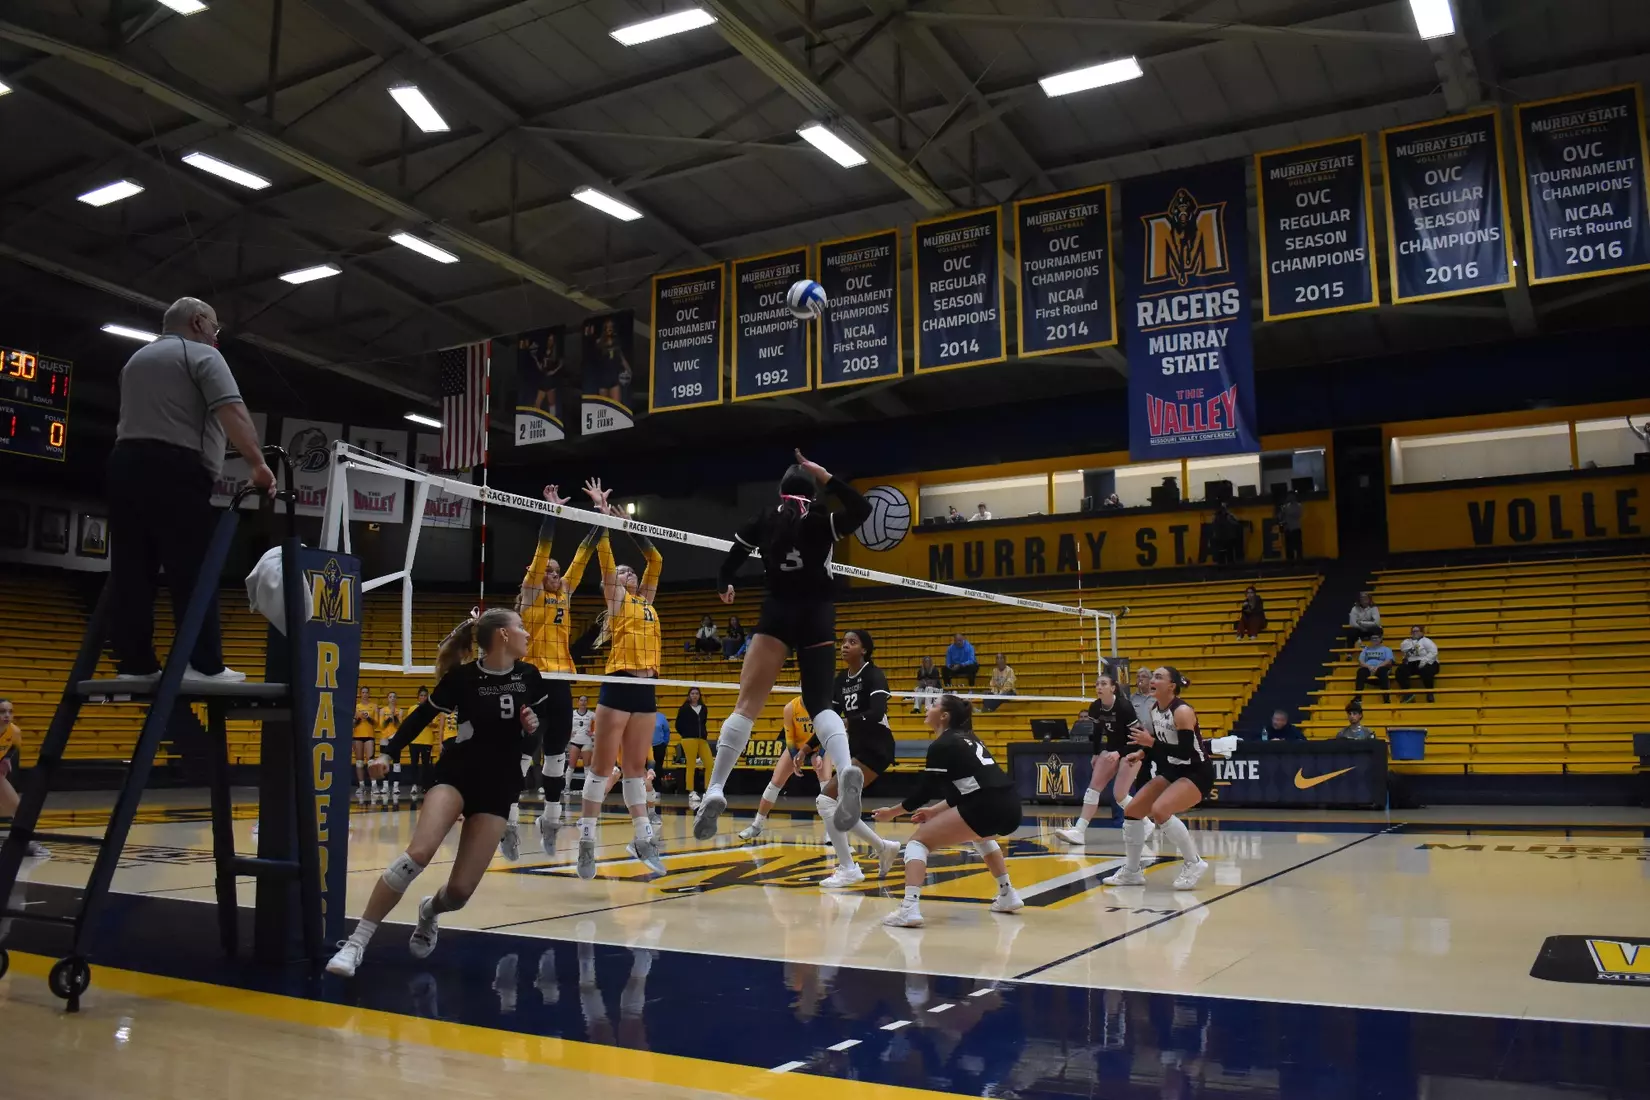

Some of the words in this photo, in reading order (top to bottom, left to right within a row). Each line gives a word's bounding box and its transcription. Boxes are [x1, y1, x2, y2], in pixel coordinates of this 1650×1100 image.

[1530, 111, 1587, 133] MURRAY
[1588, 105, 1629, 123] STATE
[1395, 137, 1448, 158] MURRAY
[1449, 130, 1487, 148] STATE
[1562, 141, 1604, 162] OVC
[1270, 160, 1318, 181] MURRAY
[1319, 154, 1355, 171] STATE
[1424, 165, 1463, 186] OVC
[1531, 157, 1636, 186] TOURNAMENT
[1295, 188, 1332, 208] OVC
[1407, 186, 1484, 211] REGULAR
[1542, 176, 1633, 201] CHAMPIONS
[1026, 210, 1067, 227] MURRAY
[1069, 204, 1099, 219] STATE
[1279, 208, 1351, 231] REGULAR
[1414, 208, 1480, 231] SEASON
[1564, 202, 1614, 223] NCAA
[923, 231, 962, 248] MURRAY
[963, 224, 991, 240] STATE
[1550, 224, 1582, 240] First
[1586, 216, 1633, 235] Round
[1049, 235, 1080, 252] OVC
[1285, 229, 1347, 251] SEASON
[1400, 226, 1500, 255] CHAMPIONS
[826, 252, 863, 267] MURRAY
[864, 245, 890, 260] STATE
[1024, 249, 1103, 272] TOURNAMENT
[1271, 247, 1365, 275] CHAMPIONS
[1565, 240, 1624, 265] 2016
[741, 268, 775, 284] MURRAY
[776, 263, 800, 277] STATE
[943, 255, 971, 272] OVC
[1425, 261, 1479, 285] 2016
[846, 274, 872, 291] OVC
[930, 272, 987, 293] REGULAR
[1031, 264, 1100, 286] CHAMPIONS
[661, 284, 692, 300] MURRAY
[694, 280, 716, 294] STATE
[759, 291, 784, 307] OVC
[826, 288, 893, 309] TOURNAMENT
[1048, 287, 1084, 305] NCAA
[1294, 281, 1344, 303] 2015
[933, 292, 983, 312] SEASON
[1035, 306, 1060, 320] First
[1063, 300, 1098, 315] Round
[1137, 287, 1240, 327] RACERS
[676, 307, 699, 322] OVC
[740, 307, 793, 325] TOURNAME
[831, 303, 890, 322] CHAMPIONS
[922, 308, 996, 332] CHAMPIONS
[658, 320, 717, 338] TOURNAMENT
[744, 319, 799, 337] CHAMPIONS
[843, 323, 876, 339] NCAA
[1046, 321, 1089, 341] 2014
[662, 334, 713, 351] CHAMPIONS
[833, 341, 854, 354] First
[856, 335, 888, 349] Round
[939, 338, 980, 358] 2014
[1148, 327, 1230, 356] MURRAY
[759, 345, 784, 359] NIVC
[39, 360, 70, 375] GUEST
[673, 358, 700, 373] WIVC
[842, 355, 879, 373] 2003
[1161, 351, 1220, 376] STATE
[50, 372, 70, 397] 11
[755, 368, 789, 387] 1992
[671, 382, 703, 399] 1989
[1176, 388, 1205, 400] THE
[45, 414, 66, 423] FOULS
[1146, 383, 1237, 437] VALLEY
[520, 423, 526, 440] 2
[586, 413, 593, 430] 5
[50, 421, 66, 447] 0
[1179, 434, 1198, 442] VALLEY
[45, 445, 63, 453] WON
[354, 488, 396, 512] VALLEY
[487, 490, 511, 504] RACER
[512, 495, 555, 513] VOLLEYBALL
[629, 521, 647, 533] RACER
[649, 526, 682, 540] VOLLEYBALL
[929, 530, 1108, 582] MURRAY
[553, 607, 564, 624] 2
[499, 693, 515, 720] 9
[844, 693, 858, 711] 22
[803, 723, 814, 733] 17
[746, 740, 783, 757] ACER
[1212, 760, 1260, 780] TATE
